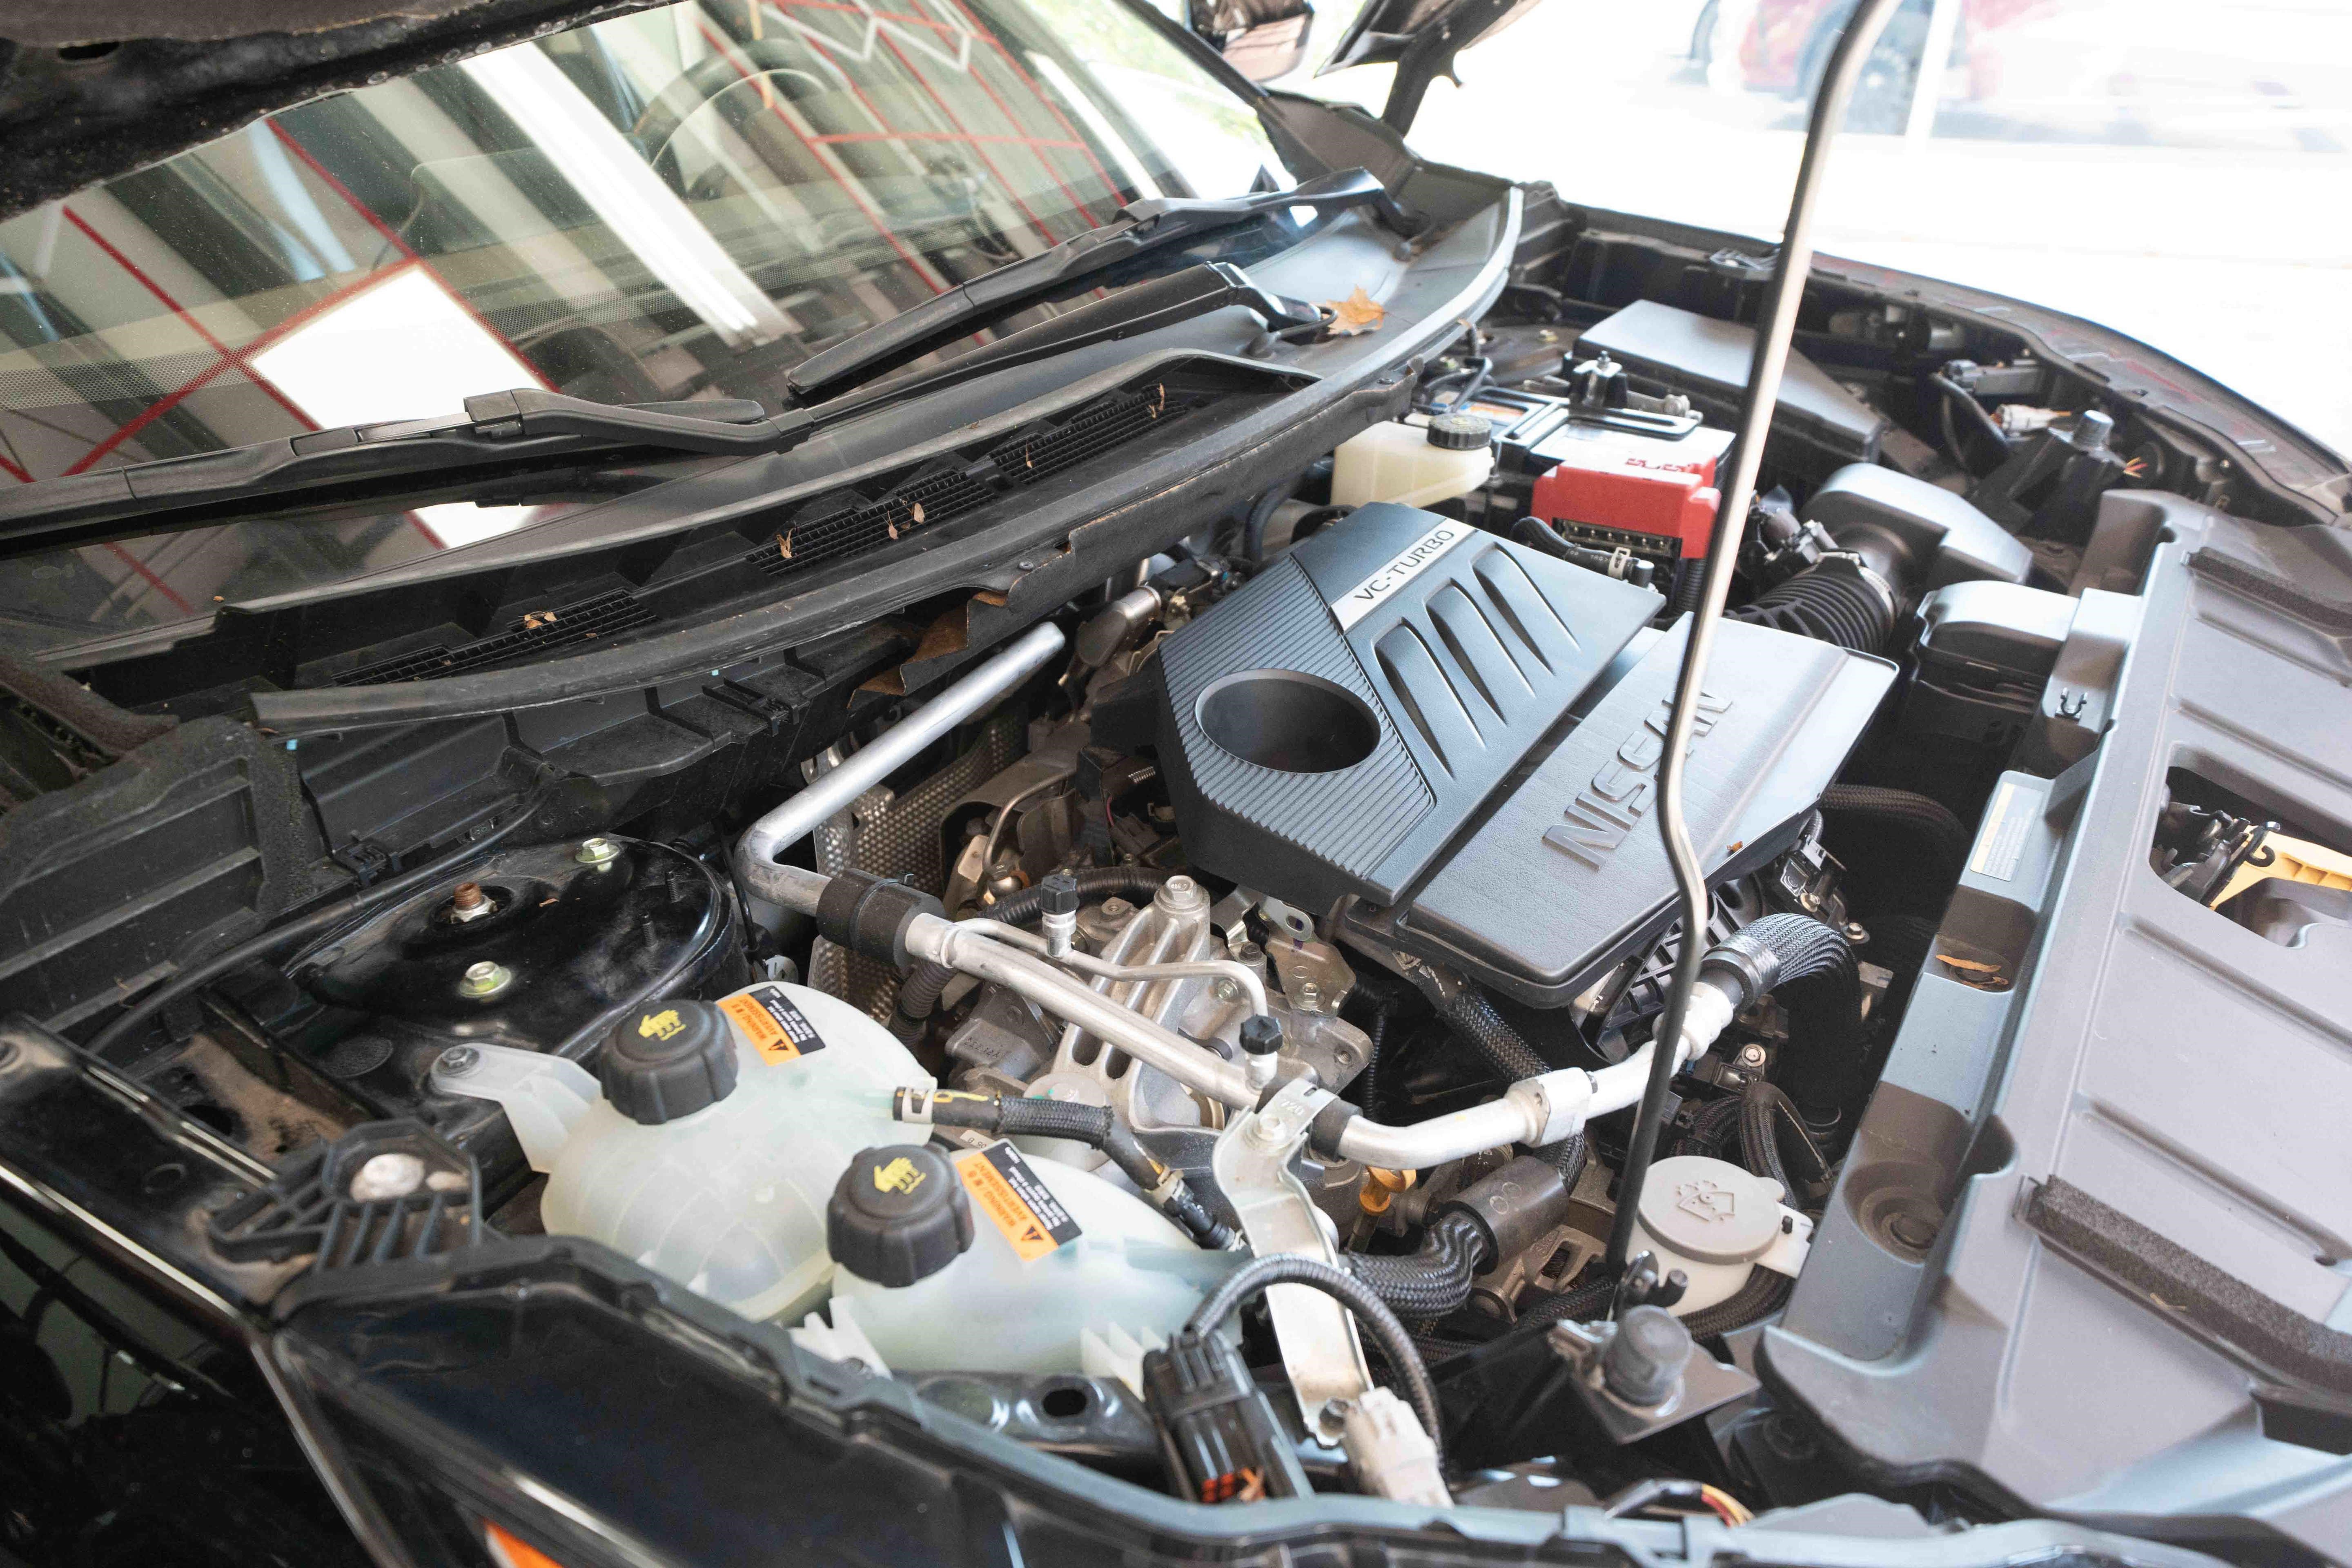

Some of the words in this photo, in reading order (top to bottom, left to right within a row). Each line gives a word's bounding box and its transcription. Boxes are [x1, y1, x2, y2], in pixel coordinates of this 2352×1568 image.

[1354, 530, 1454, 599] VC-TURBO
[1541, 691, 1733, 870] NISSAN
[739, 997, 778, 1036] AVERTISSEMENT
[742, 1015, 768, 1040] WARNING
[973, 1161, 1027, 1222] AVERTISSEMENT
[983, 1191, 1016, 1227] WARNING
